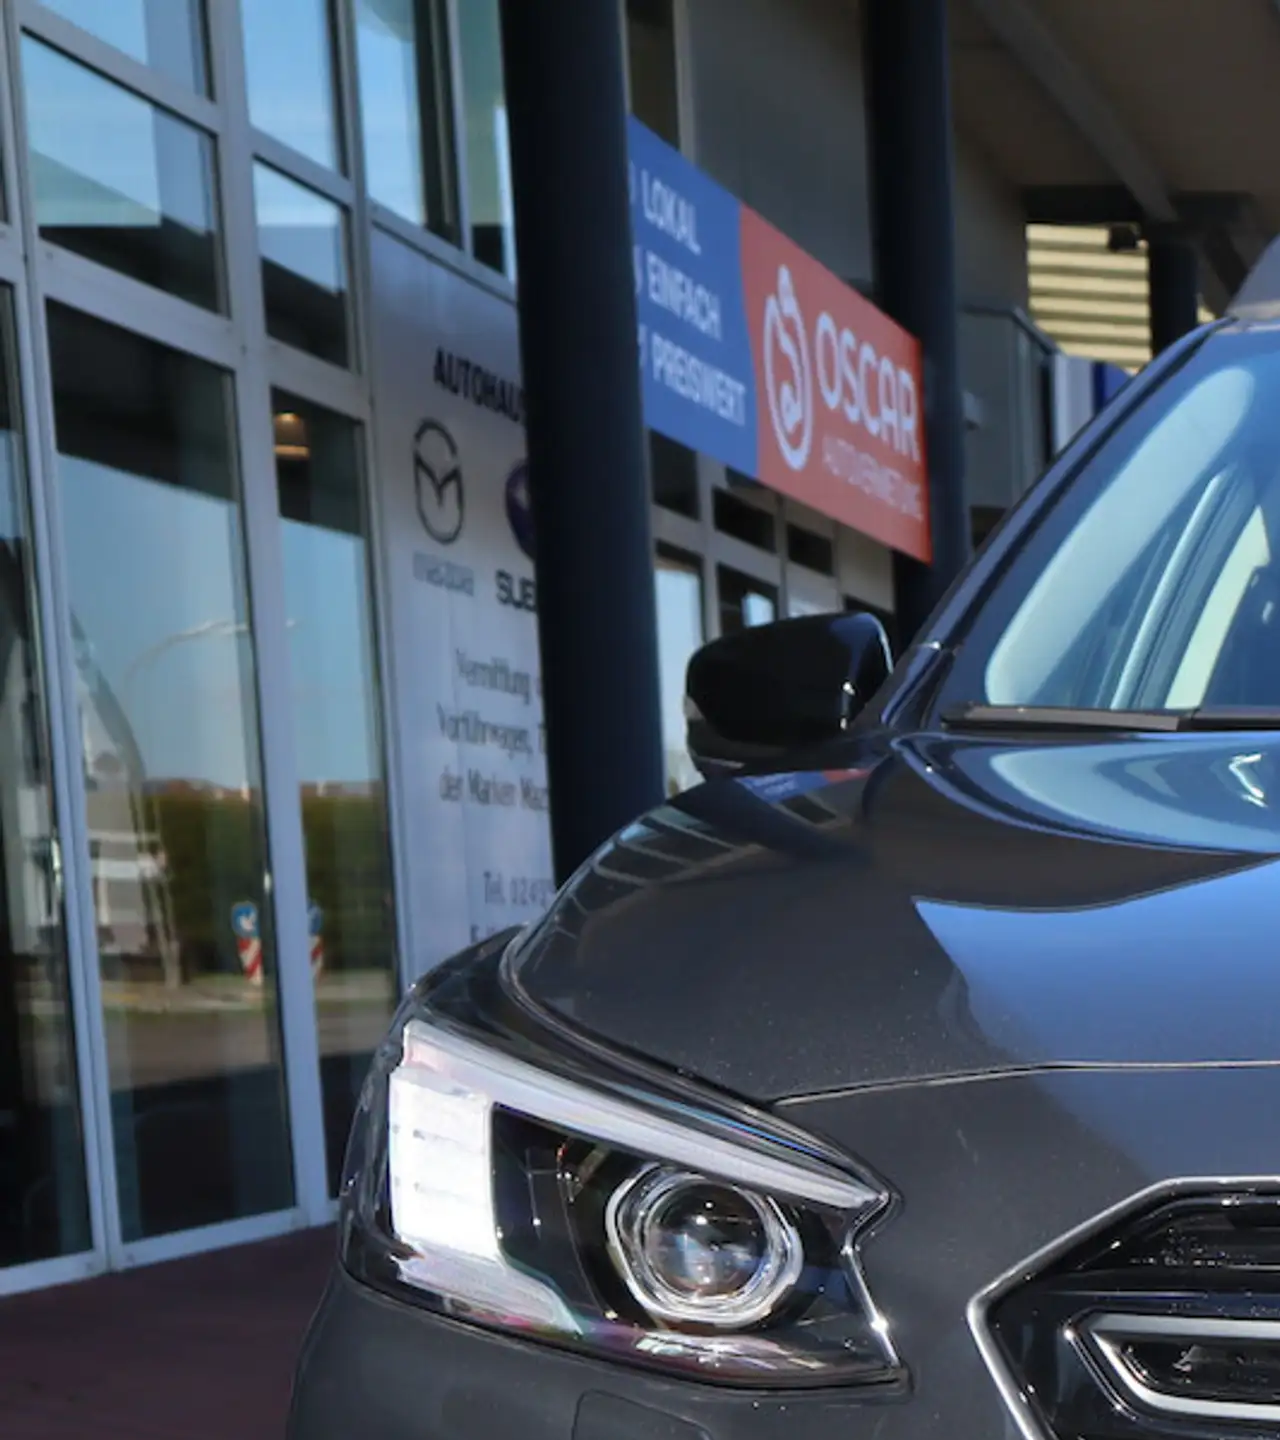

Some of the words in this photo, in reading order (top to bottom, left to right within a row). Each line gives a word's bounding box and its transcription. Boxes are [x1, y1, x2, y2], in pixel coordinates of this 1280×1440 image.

[642, 168, 701, 255] LOKAL
[647, 250, 722, 341] EINFACH
[434, 347, 524, 425] AUTOHAU
[652, 331, 746, 428] PREISWERT
[816, 312, 920, 462] OSCAR
